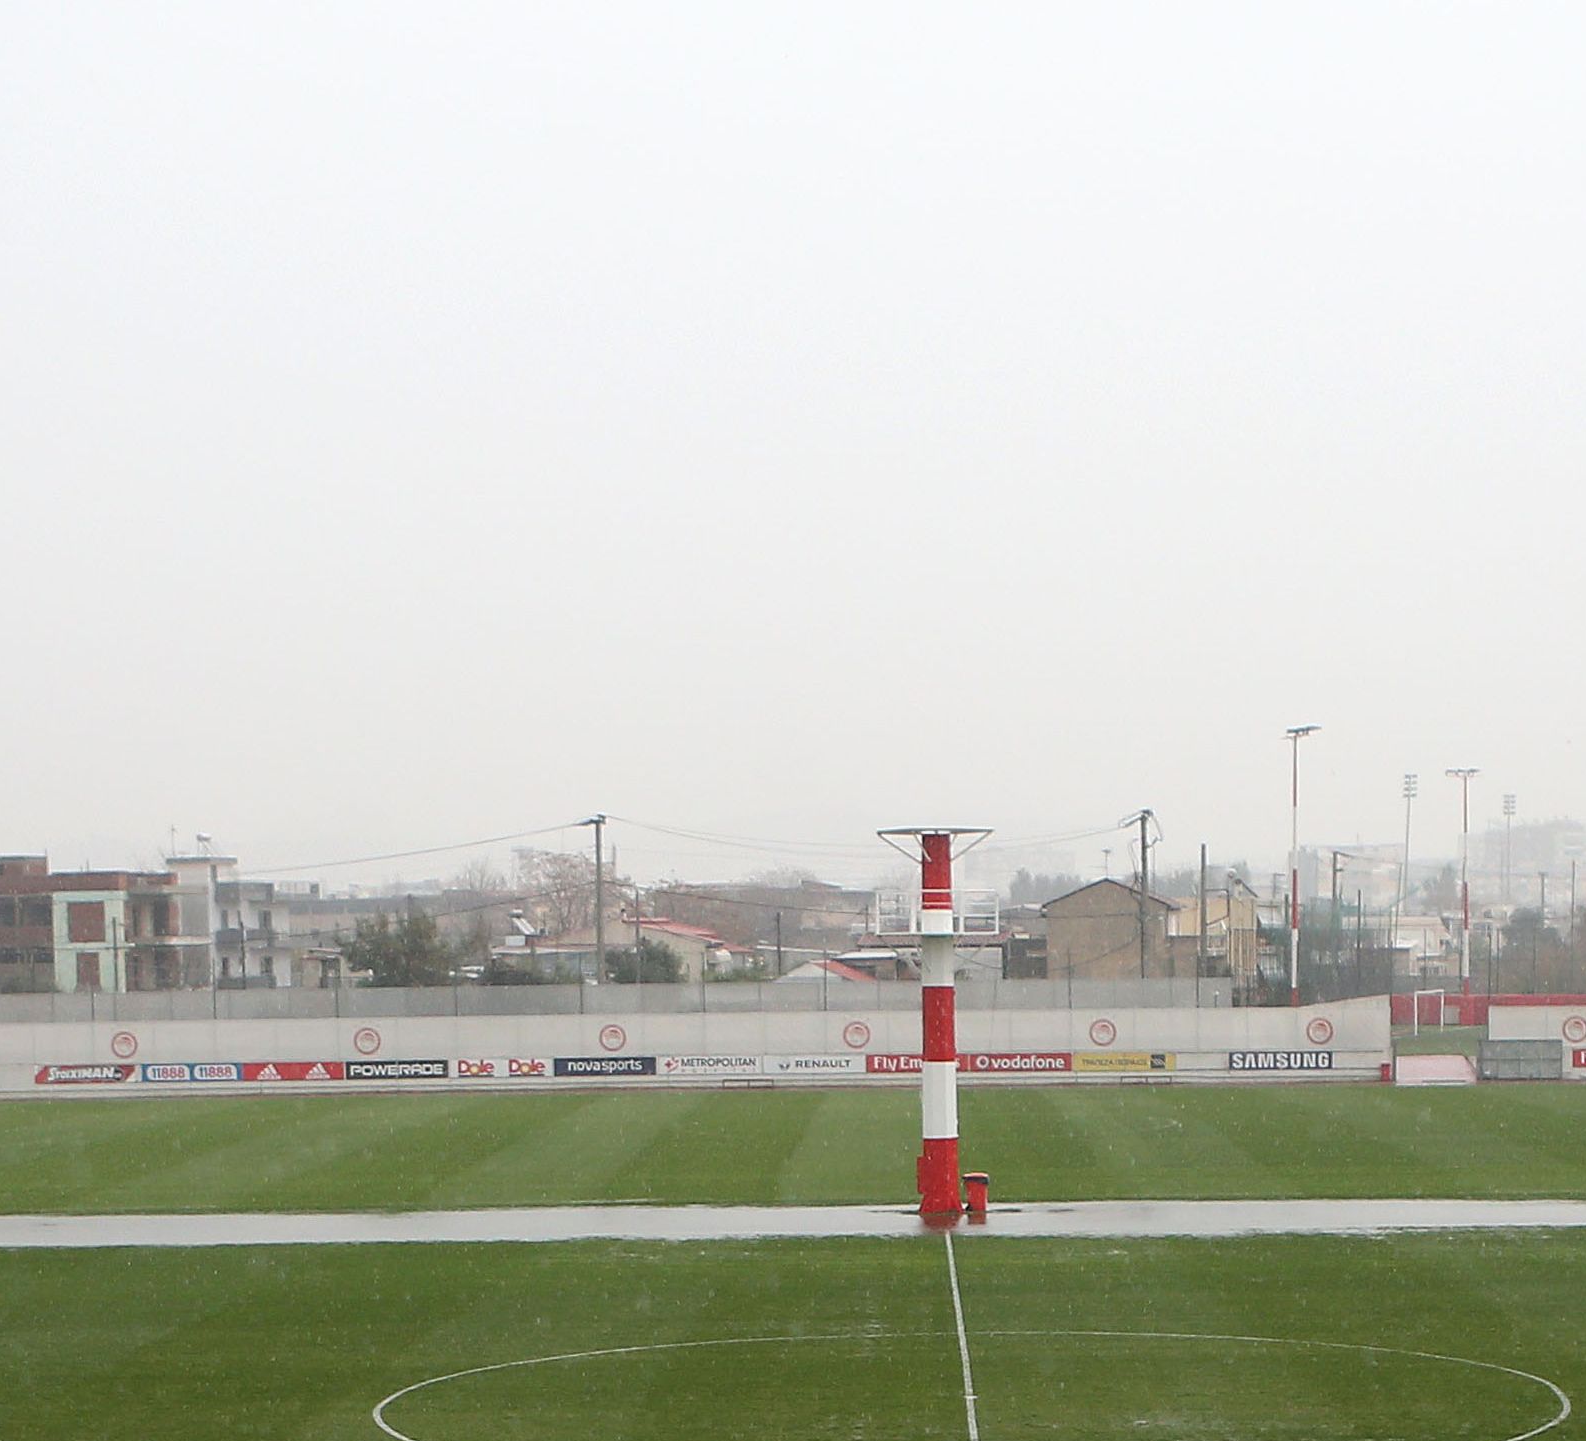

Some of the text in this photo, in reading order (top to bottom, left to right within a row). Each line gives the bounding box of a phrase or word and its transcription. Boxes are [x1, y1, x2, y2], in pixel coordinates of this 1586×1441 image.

[458, 1059, 495, 1073] Dole
[509, 1058, 546, 1073] Dole
[568, 1057, 643, 1073] novasports
[680, 1057, 757, 1067] METROPOLITAN
[795, 1058, 851, 1067] RENAULT
[874, 1056, 898, 1071] Fly
[993, 1054, 1065, 1068] vodafone
[1232, 1052, 1330, 1068] SAMSUNG
[152, 1064, 185, 1078] 11888
[199, 1063, 232, 1077] 11888
[350, 1064, 444, 1076] POWERADE
